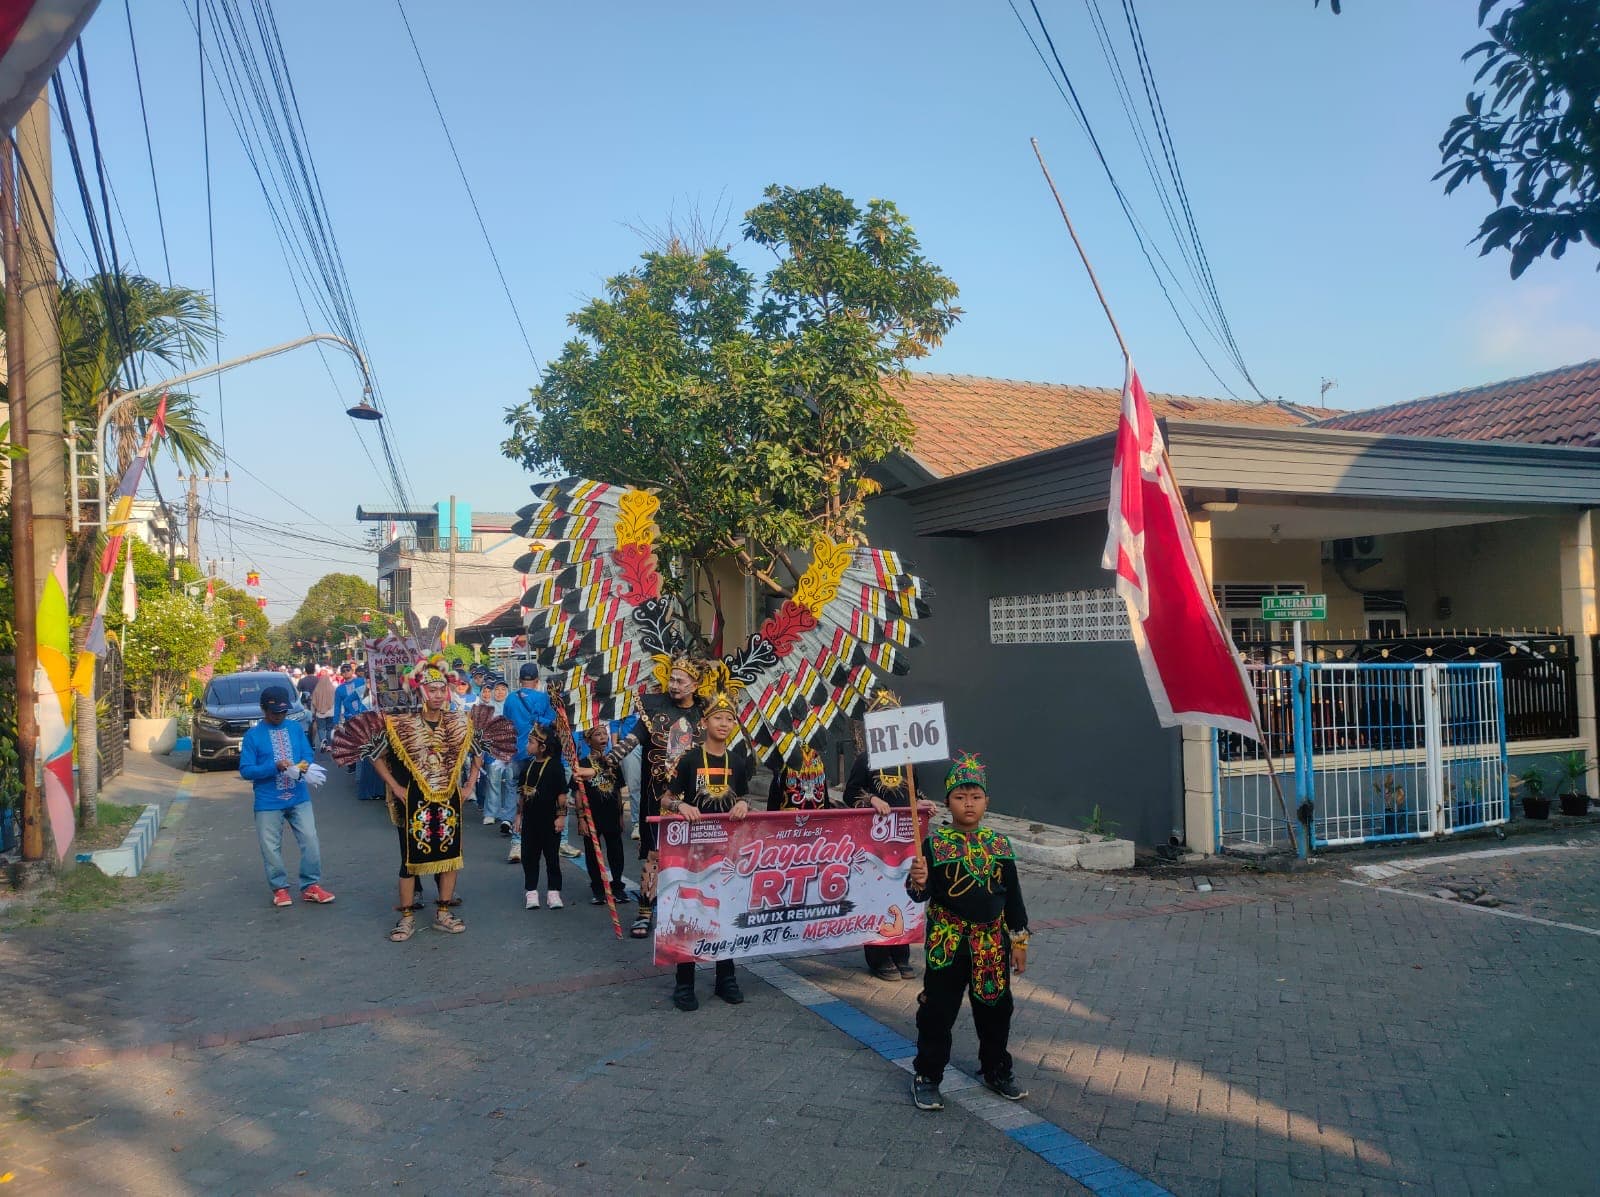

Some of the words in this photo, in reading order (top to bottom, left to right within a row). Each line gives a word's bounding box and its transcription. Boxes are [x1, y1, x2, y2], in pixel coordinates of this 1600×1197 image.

[374, 656, 412, 666] MASKO
[868, 720, 940, 754] RT.06
[667, 821, 690, 846] 81
[690, 831, 728, 839] INDONESIA
[776, 829, 792, 839] HUT
[871, 812, 898, 842] 81
[737, 835, 856, 877] Jayalah
[748, 865, 818, 910] RT
[819, 863, 850, 902] 6
[747, 913, 769, 926] RW
[771, 911, 785, 922] IX
[787, 904, 841, 920] REWWIN
[693, 933, 759, 956] Jaya-jaya
[762, 927, 783, 944] RT
[802, 914, 886, 941] MERDEKA!
